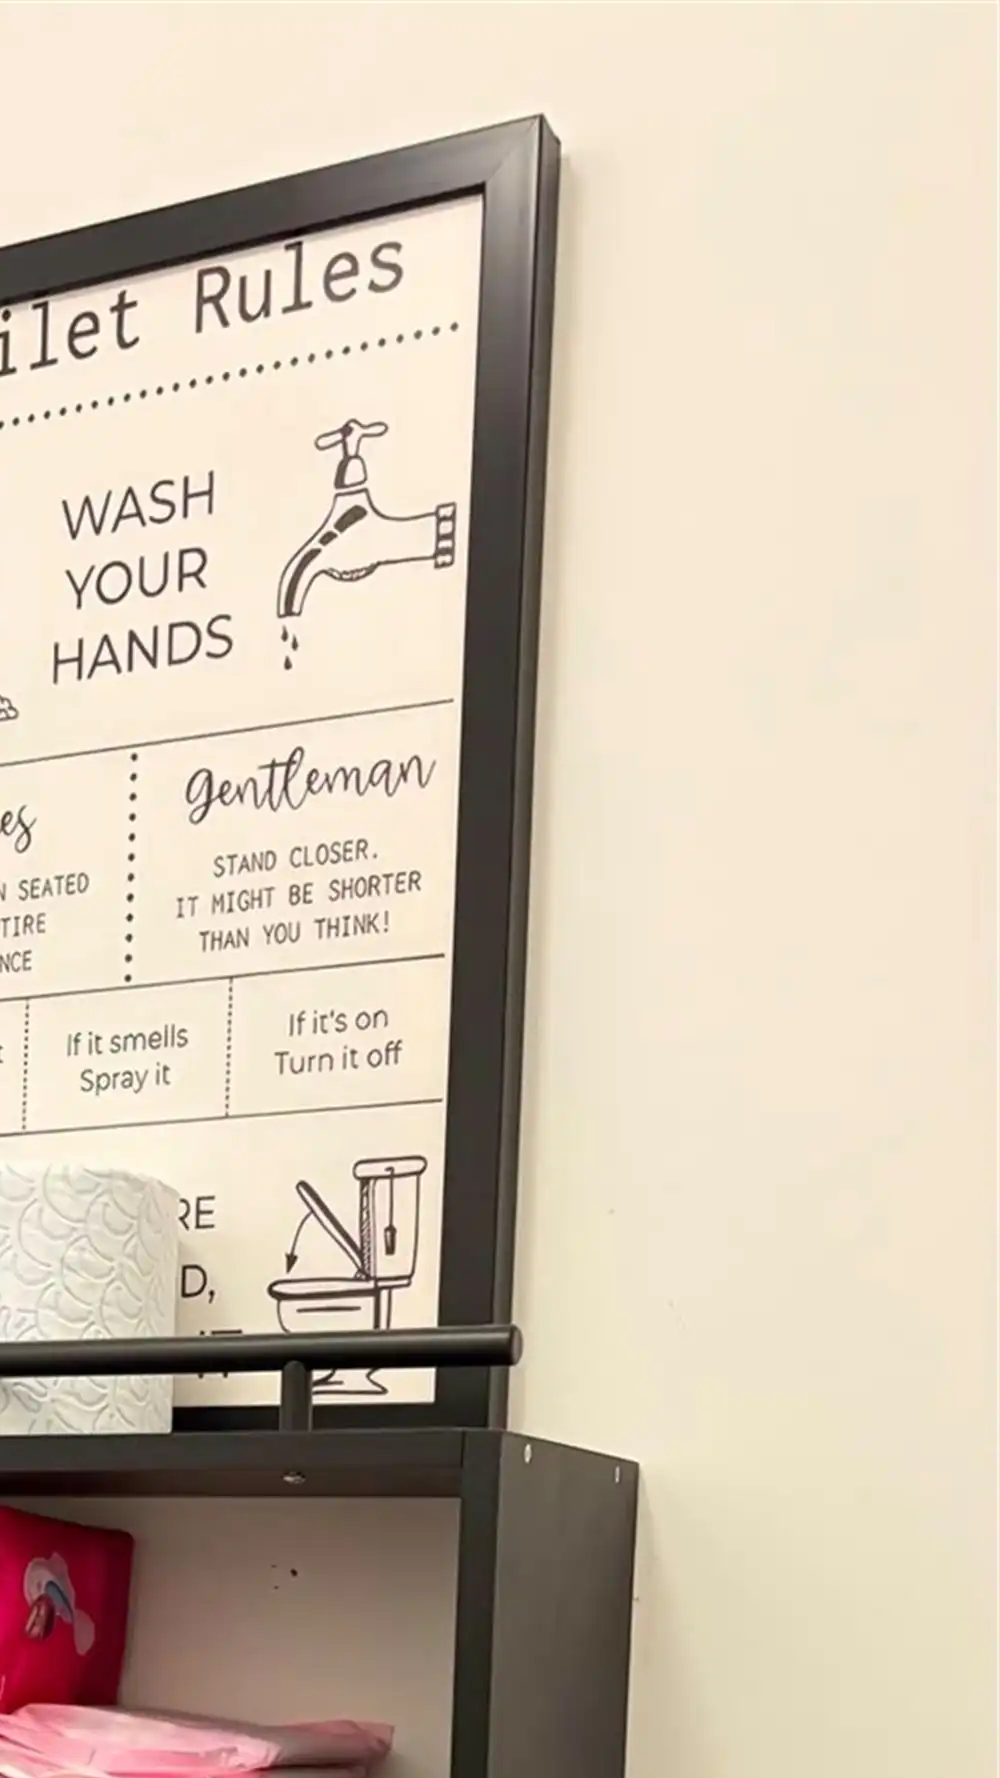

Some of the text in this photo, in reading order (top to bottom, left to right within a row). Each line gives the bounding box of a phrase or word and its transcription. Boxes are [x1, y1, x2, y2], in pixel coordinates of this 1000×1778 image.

[193, 240, 403, 333] Rules
[61, 470, 214, 540] WASH
[65, 547, 207, 609] YOUR
[52, 613, 232, 684] HANDS
[213, 838, 377, 878] STAND CLOSER.
[18, 871, 89, 901] SEATED
[176, 869, 421, 918] IT MIGHT BE SHORTER
[198, 910, 388, 952] THAN YOU THINK!
[66, 1023, 188, 1056] If it smells
[288, 1008, 389, 1036] If it's on
[273, 1039, 402, 1074] Turn it off
[80, 1061, 170, 1096] Spray it
